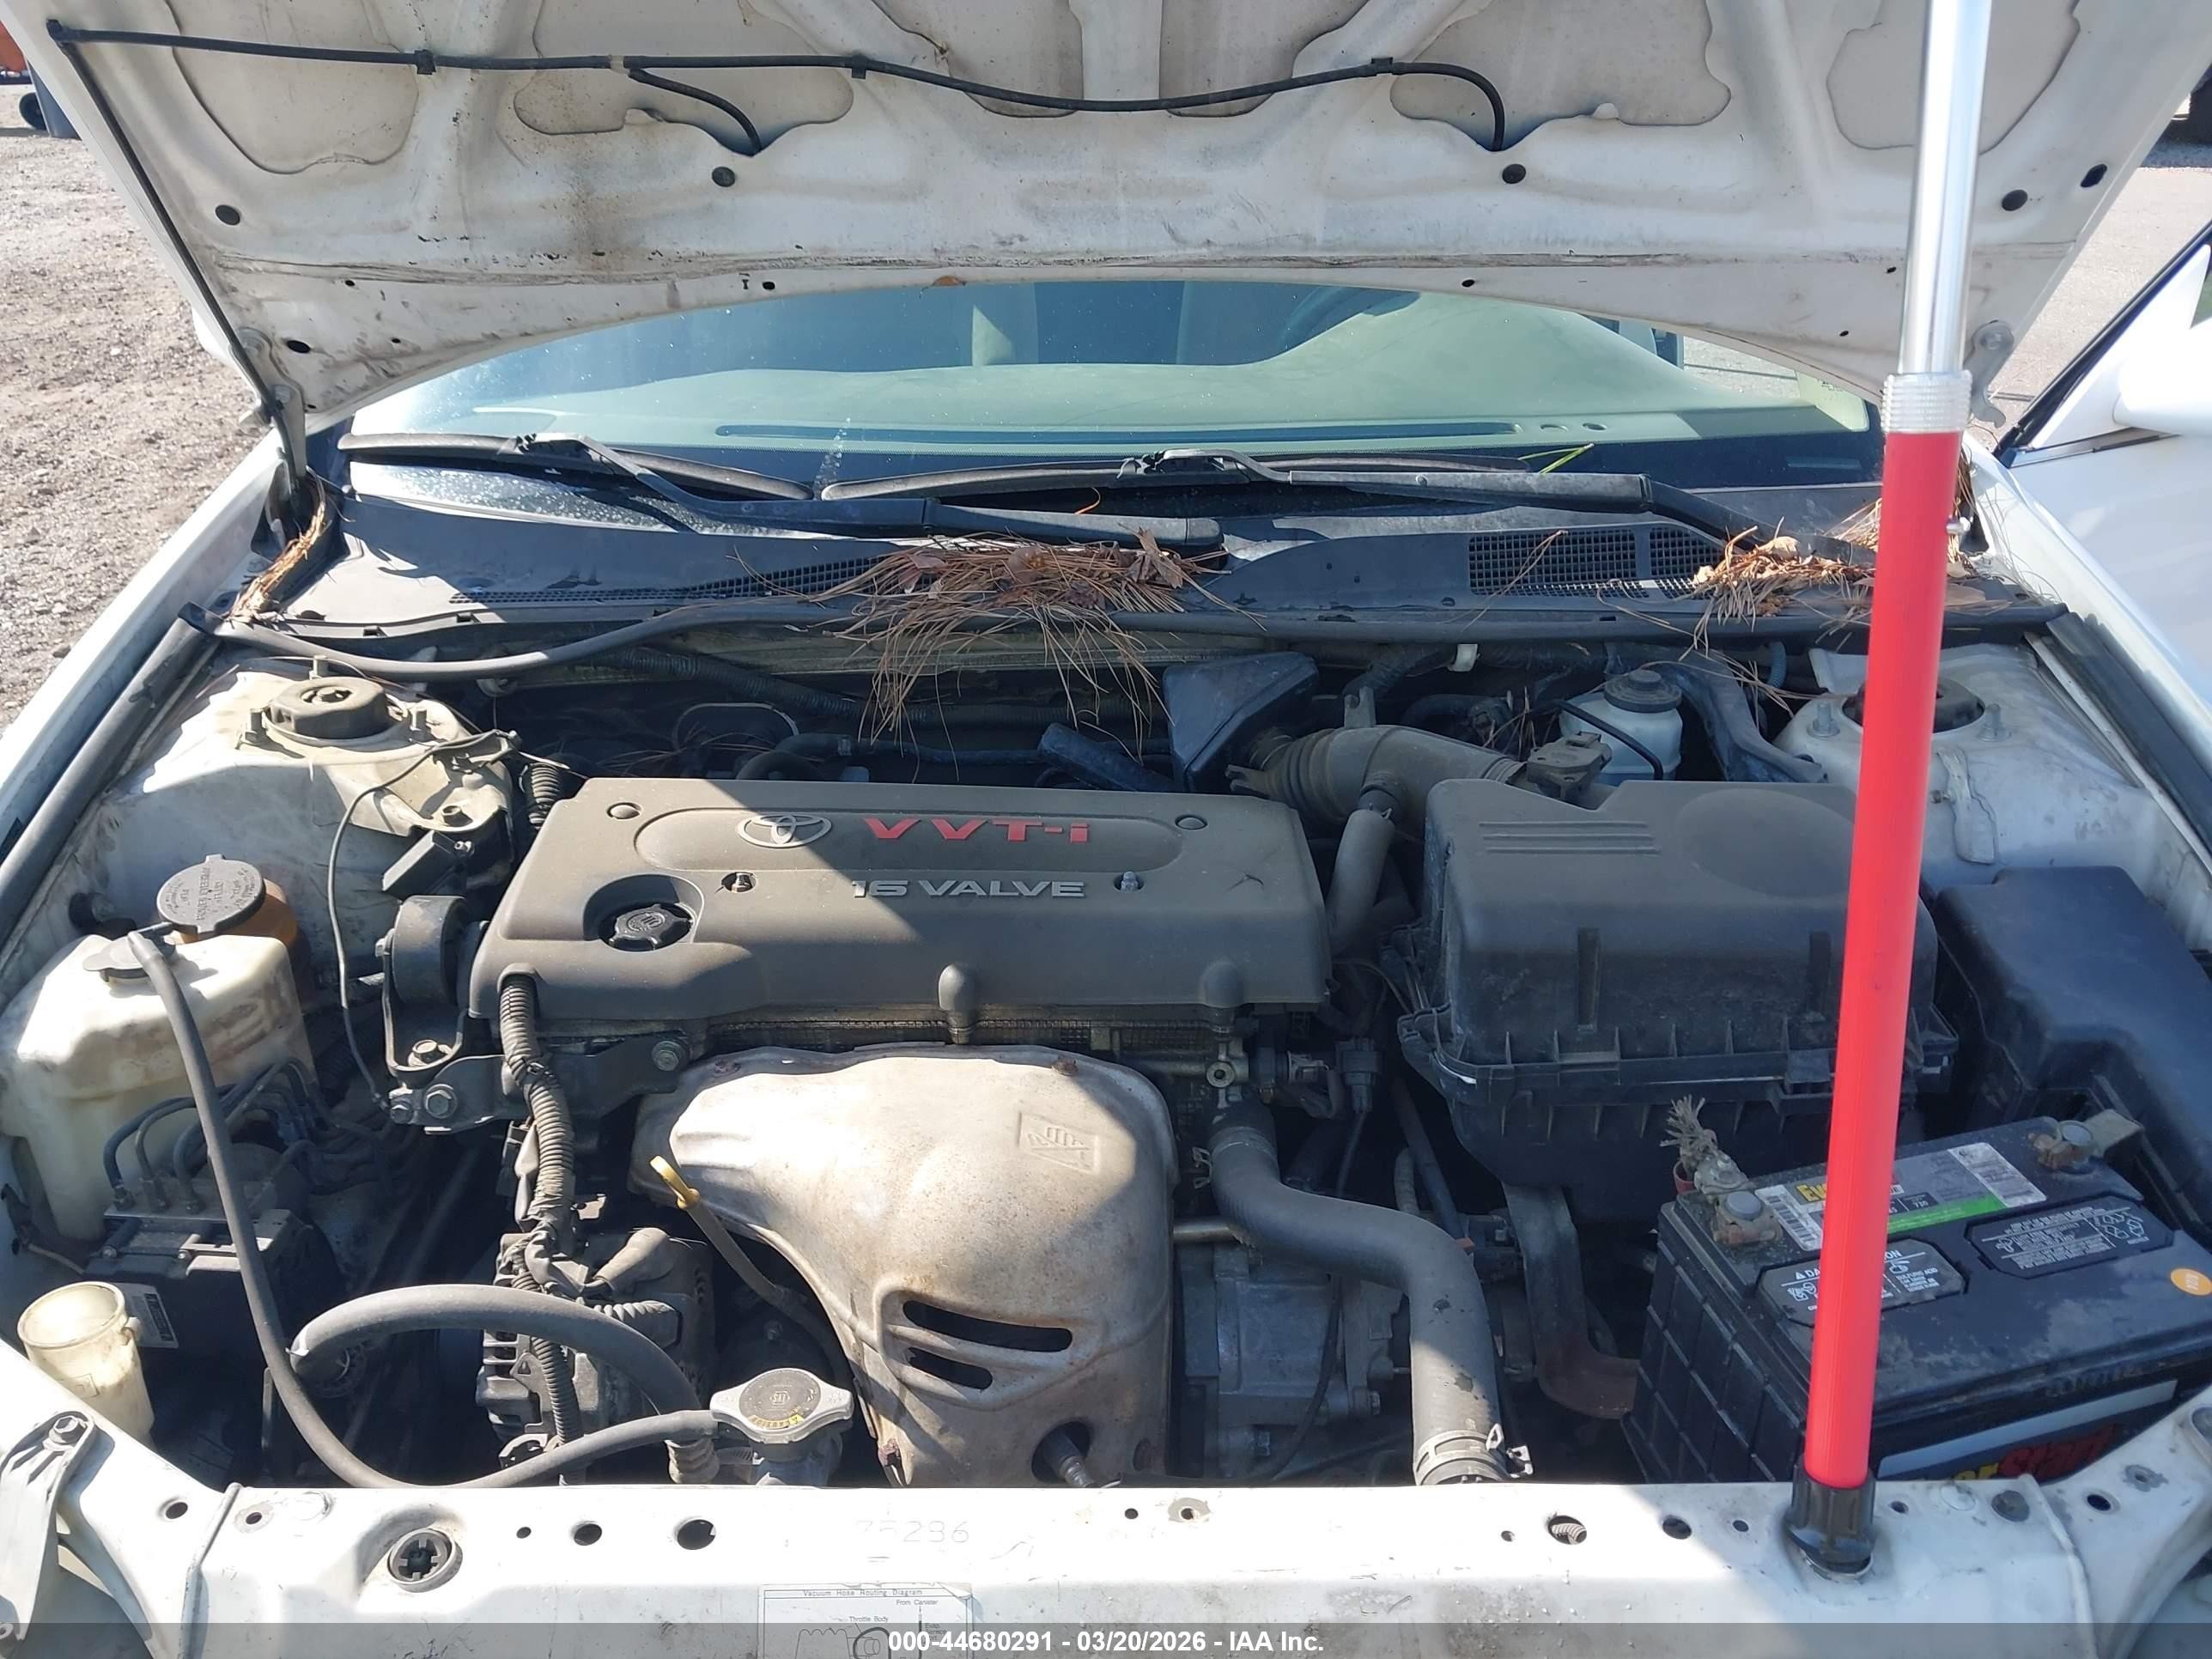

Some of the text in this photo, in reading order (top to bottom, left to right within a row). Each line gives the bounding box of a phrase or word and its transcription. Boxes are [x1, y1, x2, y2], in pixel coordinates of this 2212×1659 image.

[864, 817, 1089, 843] VVT-i
[852, 880, 1085, 898] 16 VALVE
[860, 1589, 887, 1597] Routing
